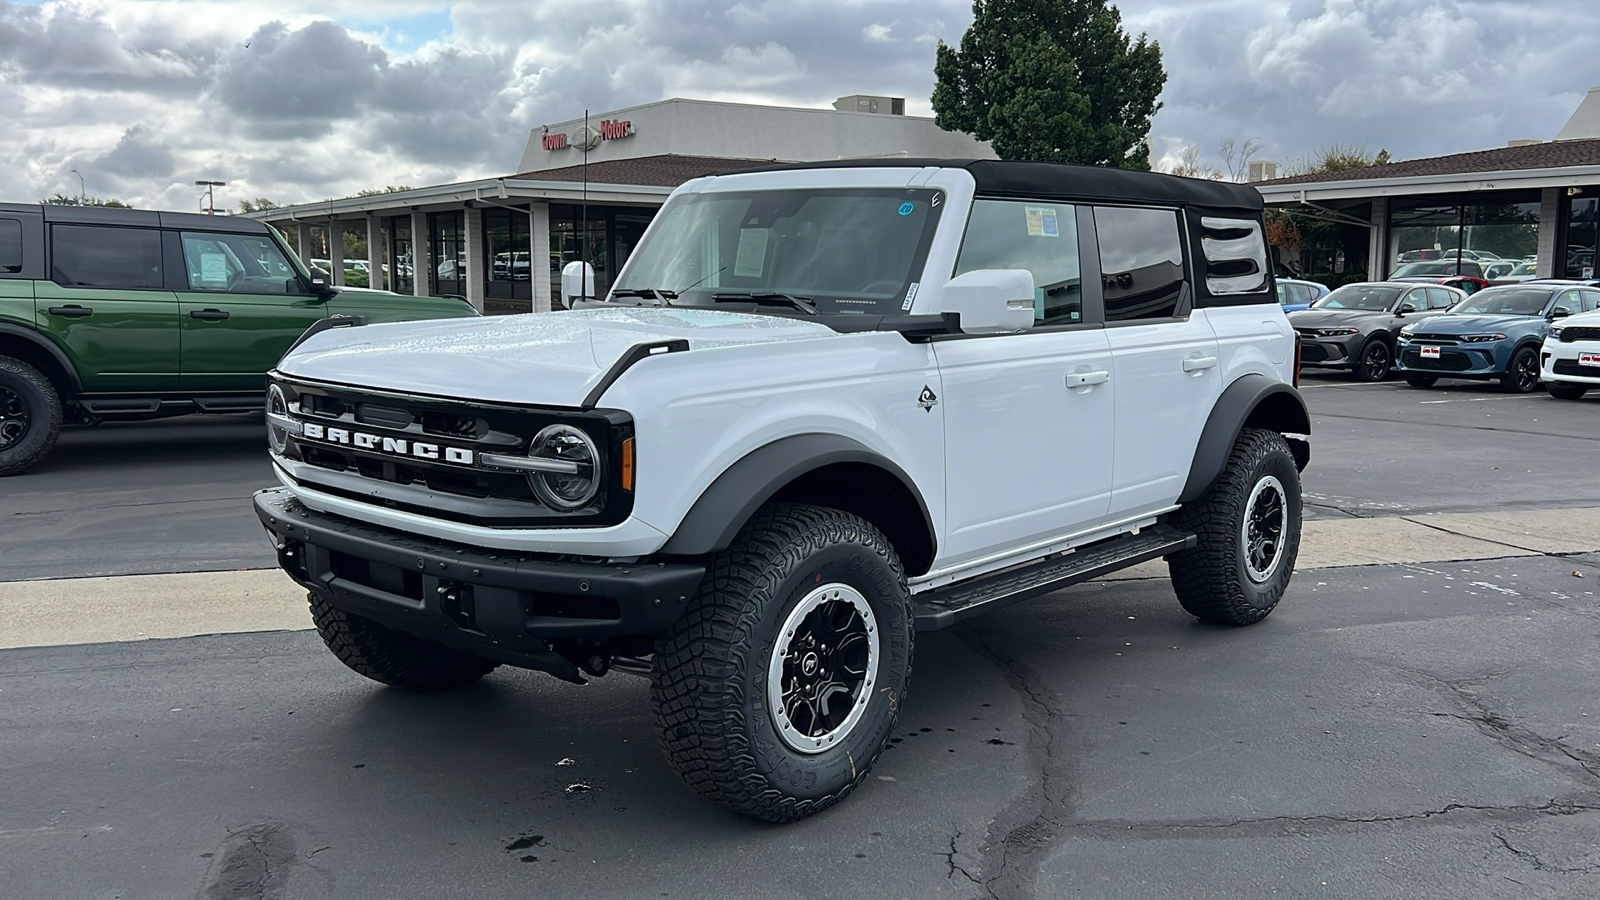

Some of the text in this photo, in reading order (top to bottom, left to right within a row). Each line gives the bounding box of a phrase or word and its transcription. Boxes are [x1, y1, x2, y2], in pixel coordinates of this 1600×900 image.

[541, 120, 630, 151] Crown Motors
[931, 191, 941, 208] E
[304, 422, 473, 464] BRONCO
[847, 553, 903, 688] GOODYEAR
[750, 643, 817, 790] GOODYEAR
